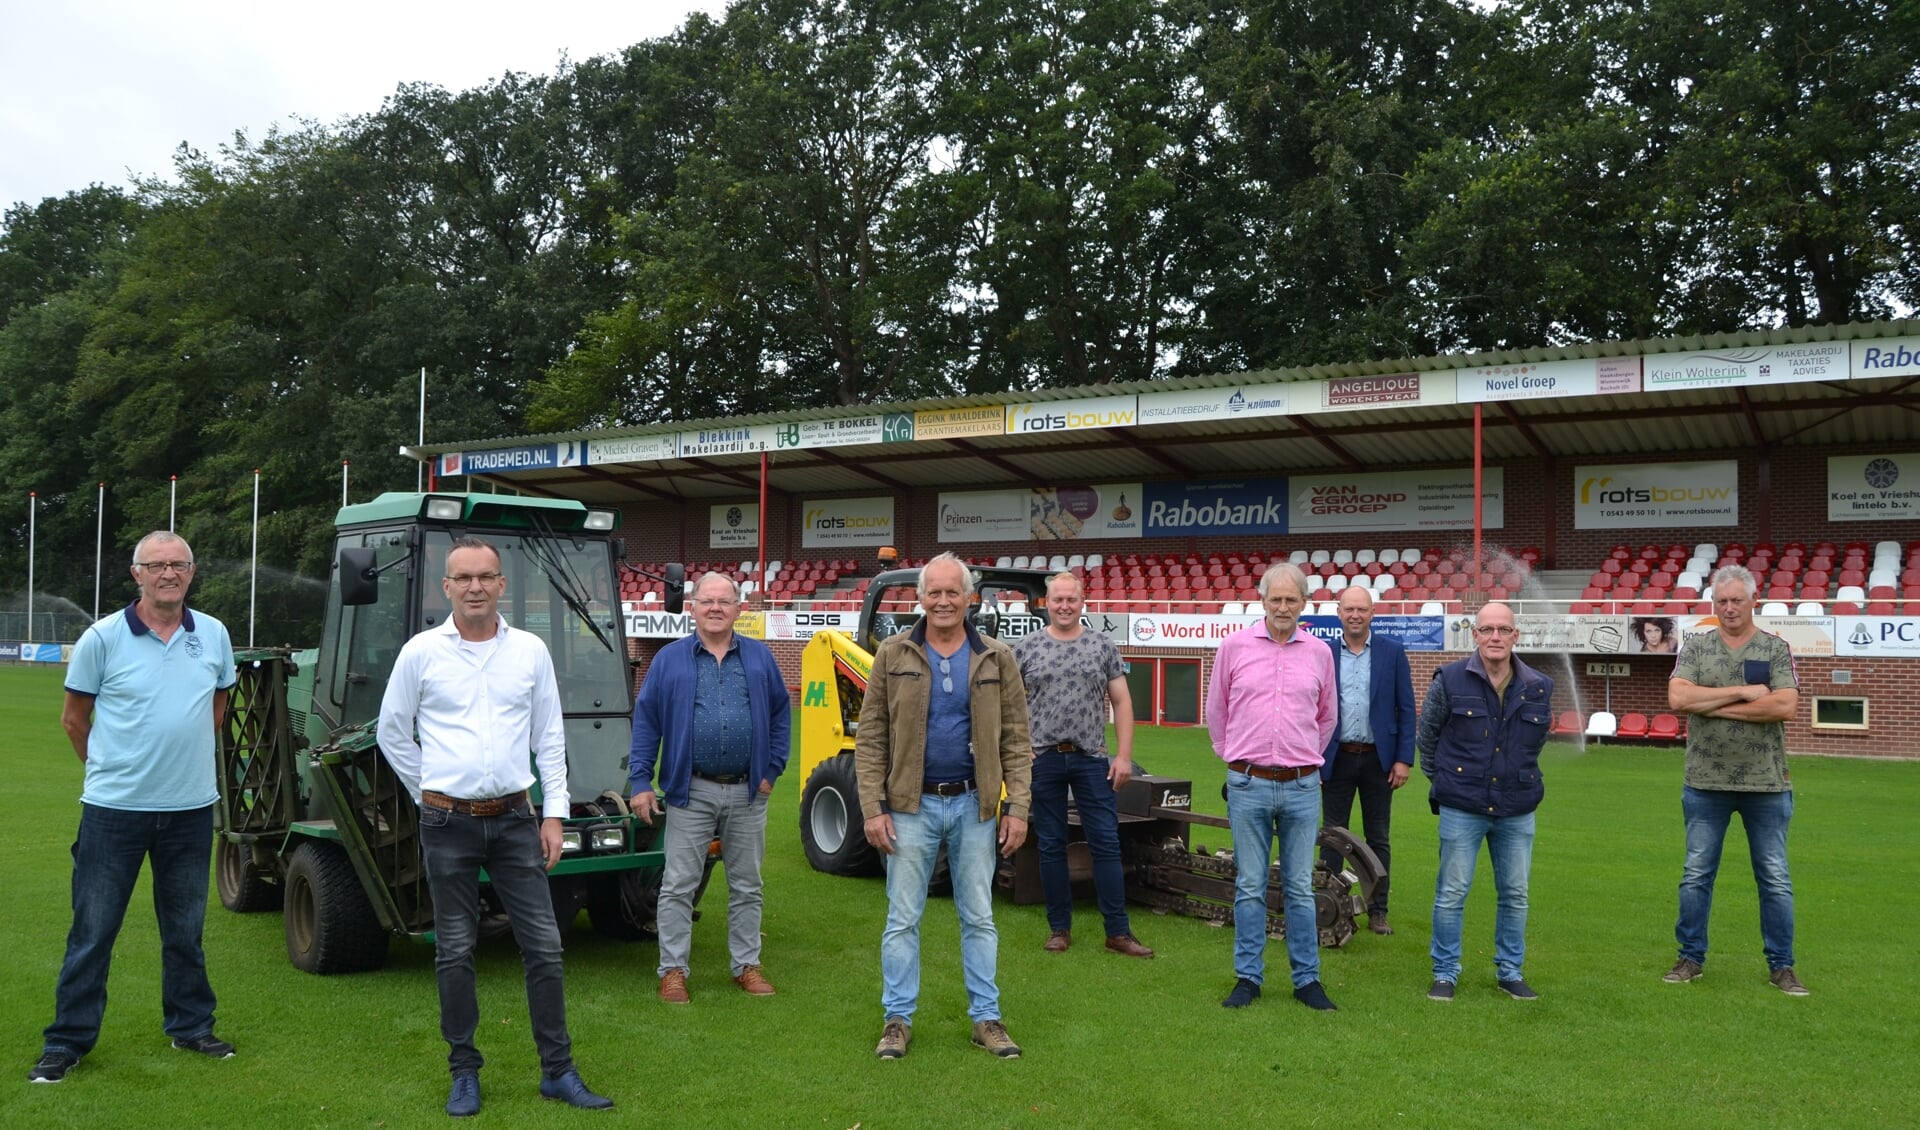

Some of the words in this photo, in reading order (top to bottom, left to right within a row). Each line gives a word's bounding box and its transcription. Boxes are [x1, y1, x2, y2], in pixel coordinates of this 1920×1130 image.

[1776, 347, 1842, 358] MAKELAARDIJ
[1788, 357, 1831, 367] TAXATIES
[1651, 369, 1682, 380] Klein
[1686, 365, 1747, 378] Wolterink
[1792, 367, 1826, 376] ADVIES
[1331, 378, 1418, 394] ANGELIQUE
[1486, 376, 1518, 391] Novel
[1521, 376, 1556, 389] Groep
[1331, 392, 1418, 404] WOMENS-WEAR
[918, 412, 946, 424] EGGINK
[950, 408, 1001, 421] MAALDERINK
[1141, 404, 1221, 417] INSTALLATIEBEDRIJF
[823, 421, 835, 430] TE
[839, 418, 878, 429] BOKKEL
[1023, 410, 1135, 431] rotsbouw
[699, 428, 750, 443] Blekkink
[917, 423, 1001, 437] GARANTIEMAKELAARS
[683, 441, 744, 455] Makelaardij
[749, 441, 769, 451] o.g.
[468, 449, 551, 470] TRADEMED.NL
[1311, 485, 1357, 495] VAN
[1418, 483, 1475, 491] Elektrogroothande
[1310, 493, 1407, 505] EGMOND
[1600, 486, 1730, 503] rotsbouw
[1831, 492, 1857, 500] Koel
[1148, 495, 1282, 528] Rabobank
[1310, 504, 1388, 515] GROEP
[1666, 507, 1731, 515] www.rotsbouw.nl
[816, 515, 890, 530] rotsbouw
[946, 514, 982, 524] Prinzen
[1418, 518, 1474, 526] www.vanegmond
[795, 614, 841, 626] DSG
[1161, 621, 1206, 639] Word
[1305, 627, 1343, 640] virup
[1880, 622, 1914, 642] PC
[1590, 664, 1627, 674] A.ZS.V.
